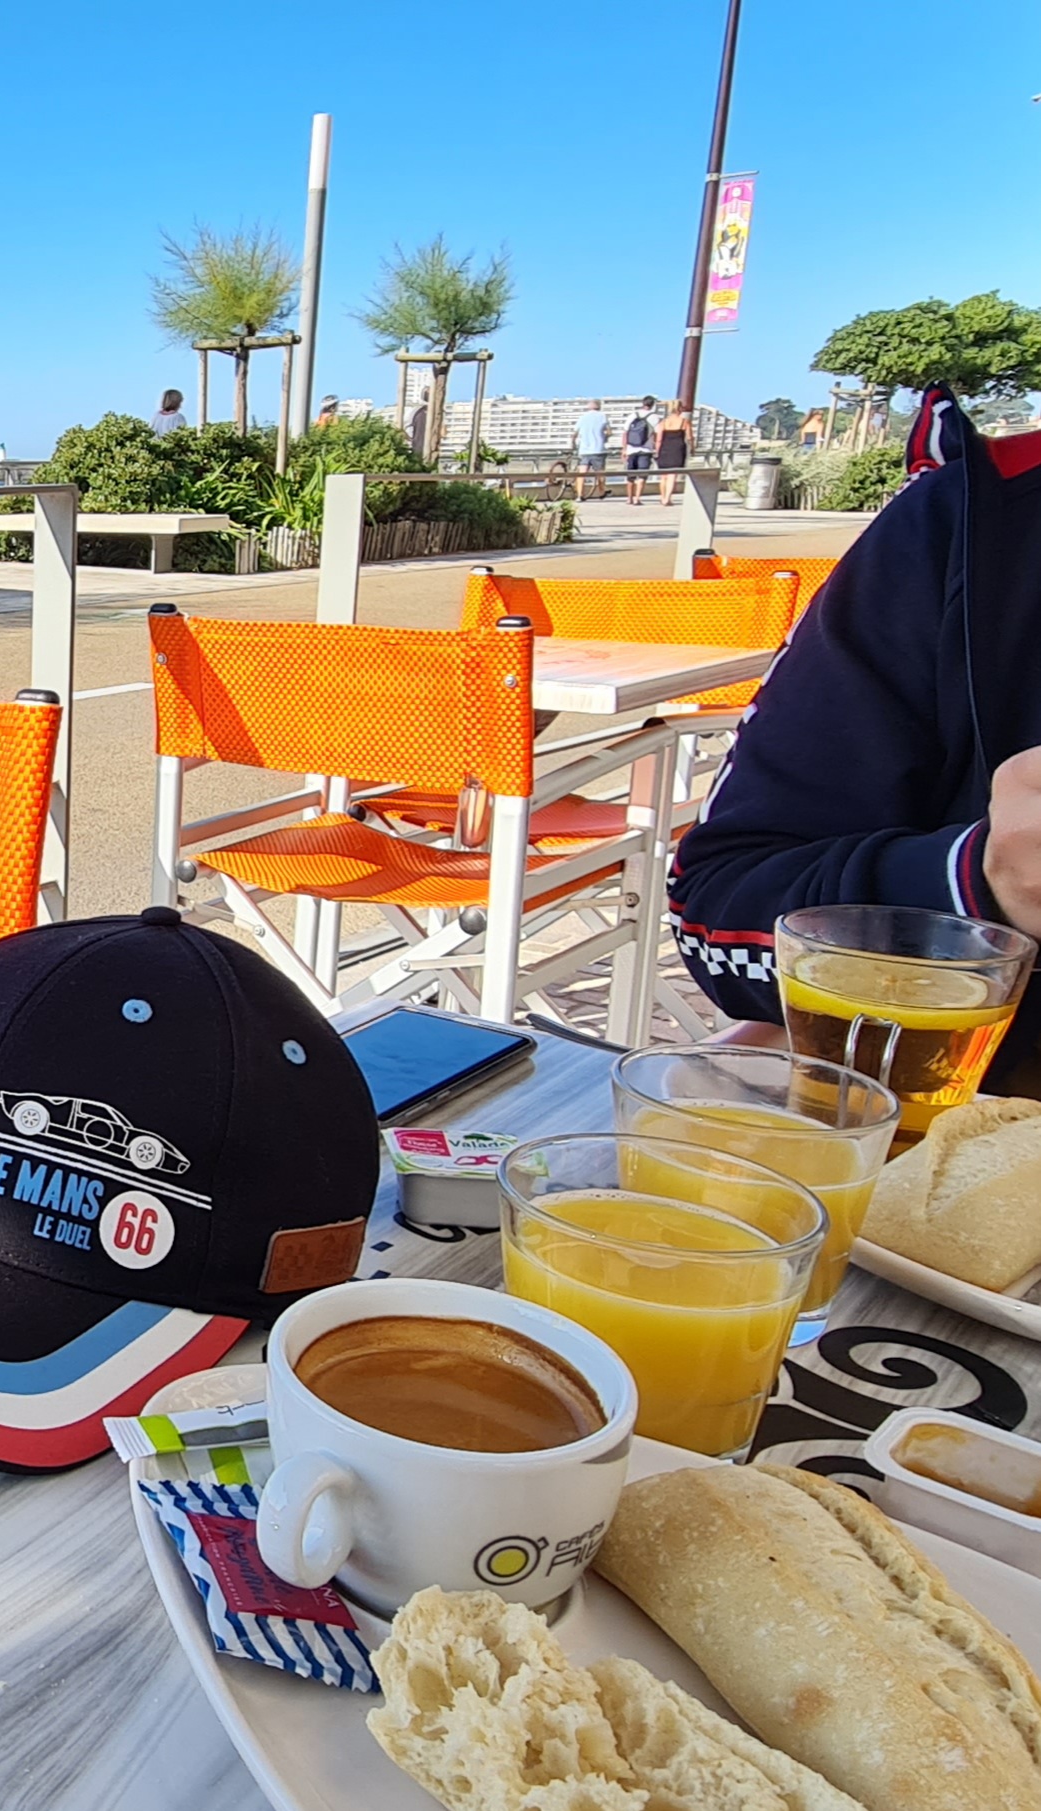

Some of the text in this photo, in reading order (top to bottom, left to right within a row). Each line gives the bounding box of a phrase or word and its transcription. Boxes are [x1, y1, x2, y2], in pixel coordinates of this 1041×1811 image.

[12, 1159, 105, 1221] MANS
[33, 1213, 93, 1251] LE DUEL
[113, 1202, 159, 1257] 66
